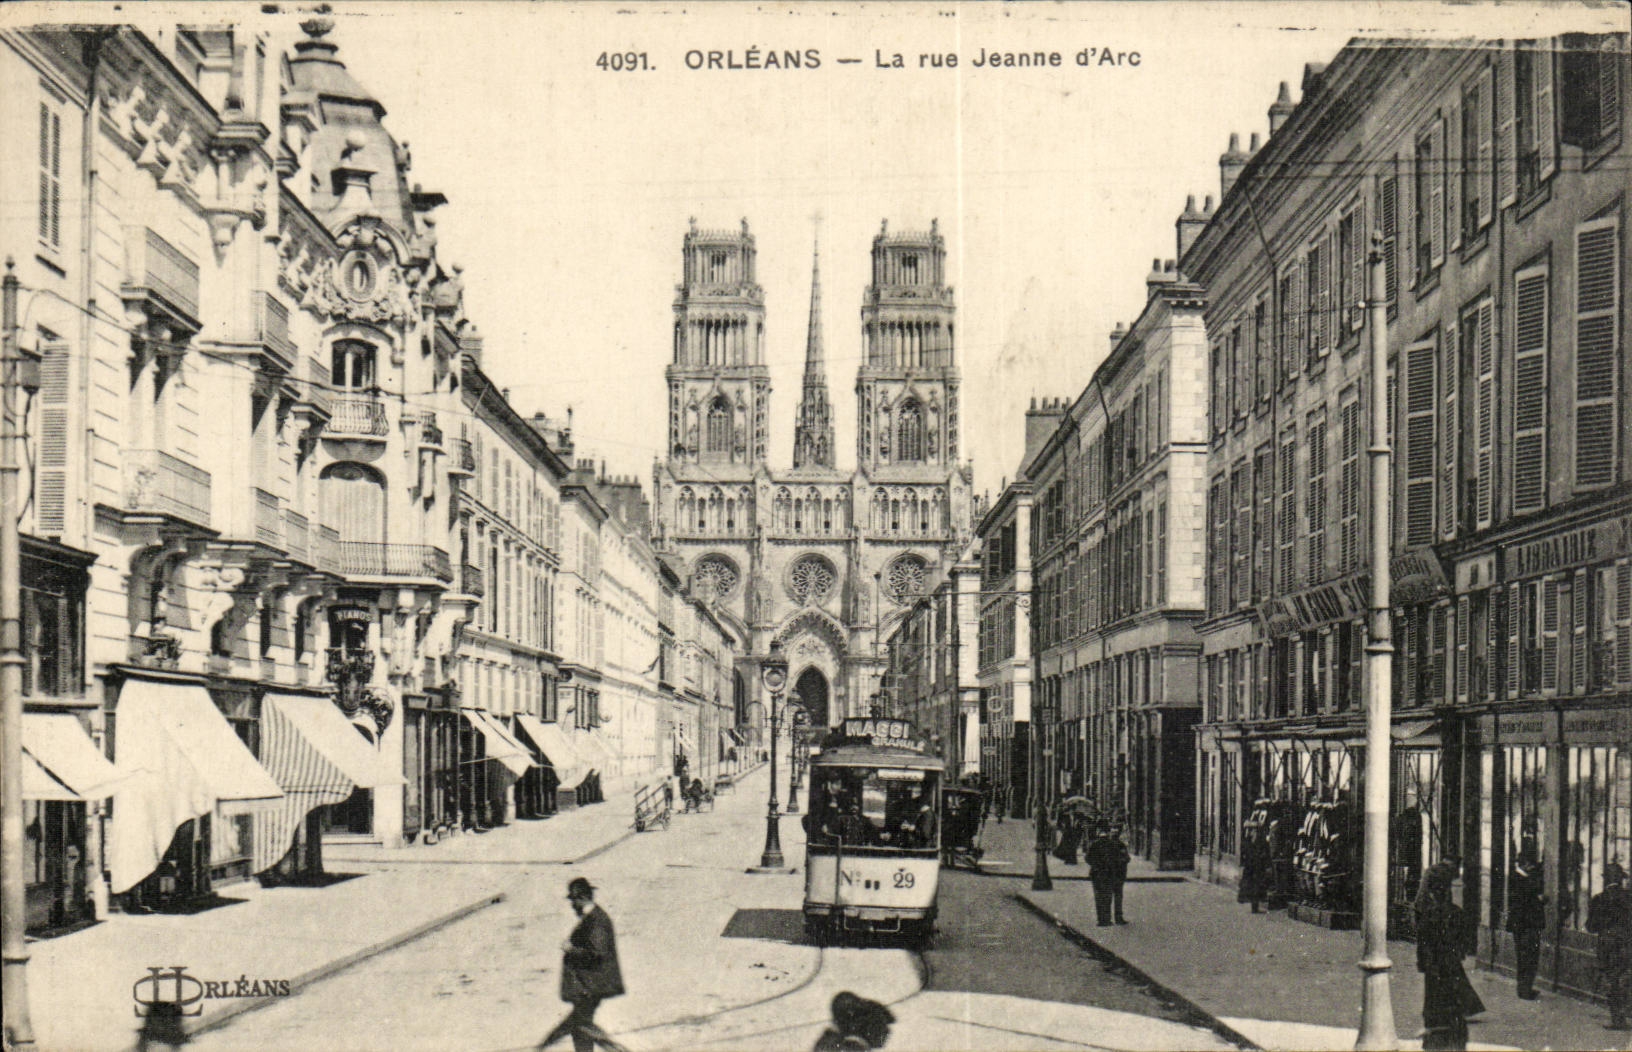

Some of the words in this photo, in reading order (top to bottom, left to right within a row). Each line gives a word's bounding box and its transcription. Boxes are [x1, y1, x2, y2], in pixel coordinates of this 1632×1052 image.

[1517, 527, 1596, 577] LIBRAIRIE
[334, 609, 372, 622] PIANOS
[846, 720, 910, 739] MAGGI
[893, 871, 915, 888] 29
